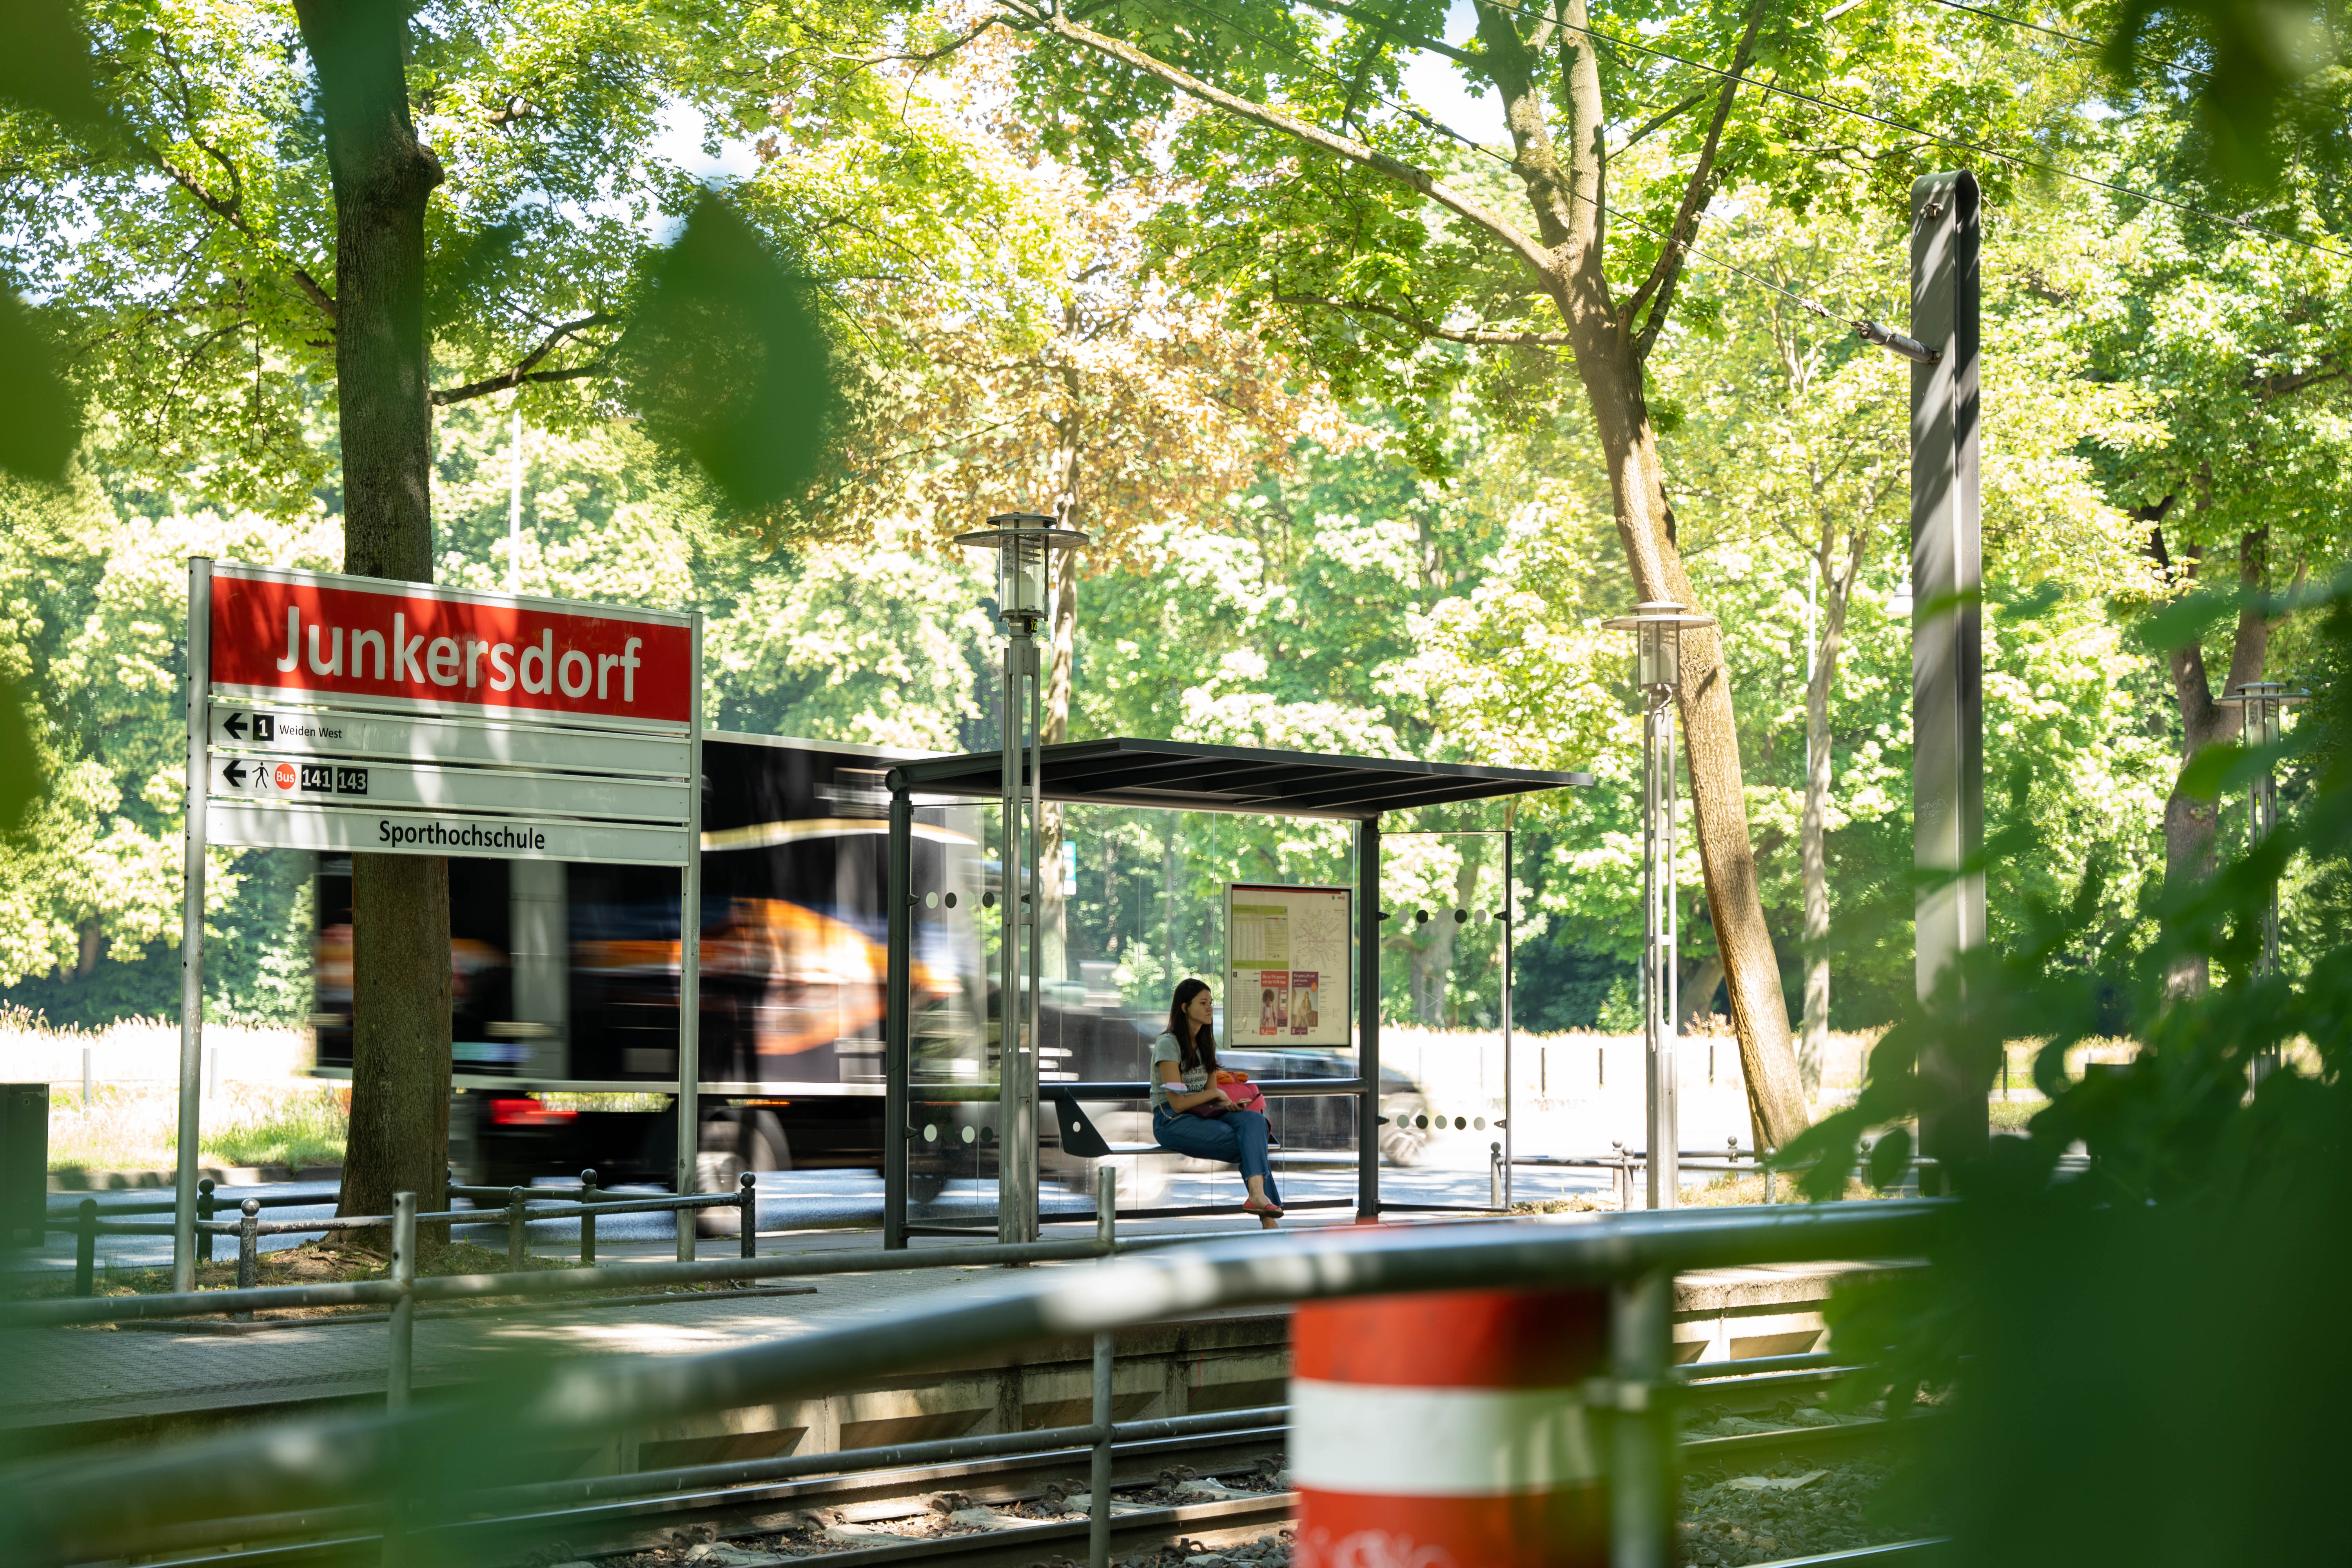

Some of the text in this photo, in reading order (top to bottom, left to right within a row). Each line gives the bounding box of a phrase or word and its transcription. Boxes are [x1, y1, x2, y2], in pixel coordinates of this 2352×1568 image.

[276, 606, 642, 702] Junkersdorf
[259, 719, 342, 739] 1 Weiden West
[276, 769, 367, 790] Bus 141 143
[379, 820, 545, 850] Sporthochschule
